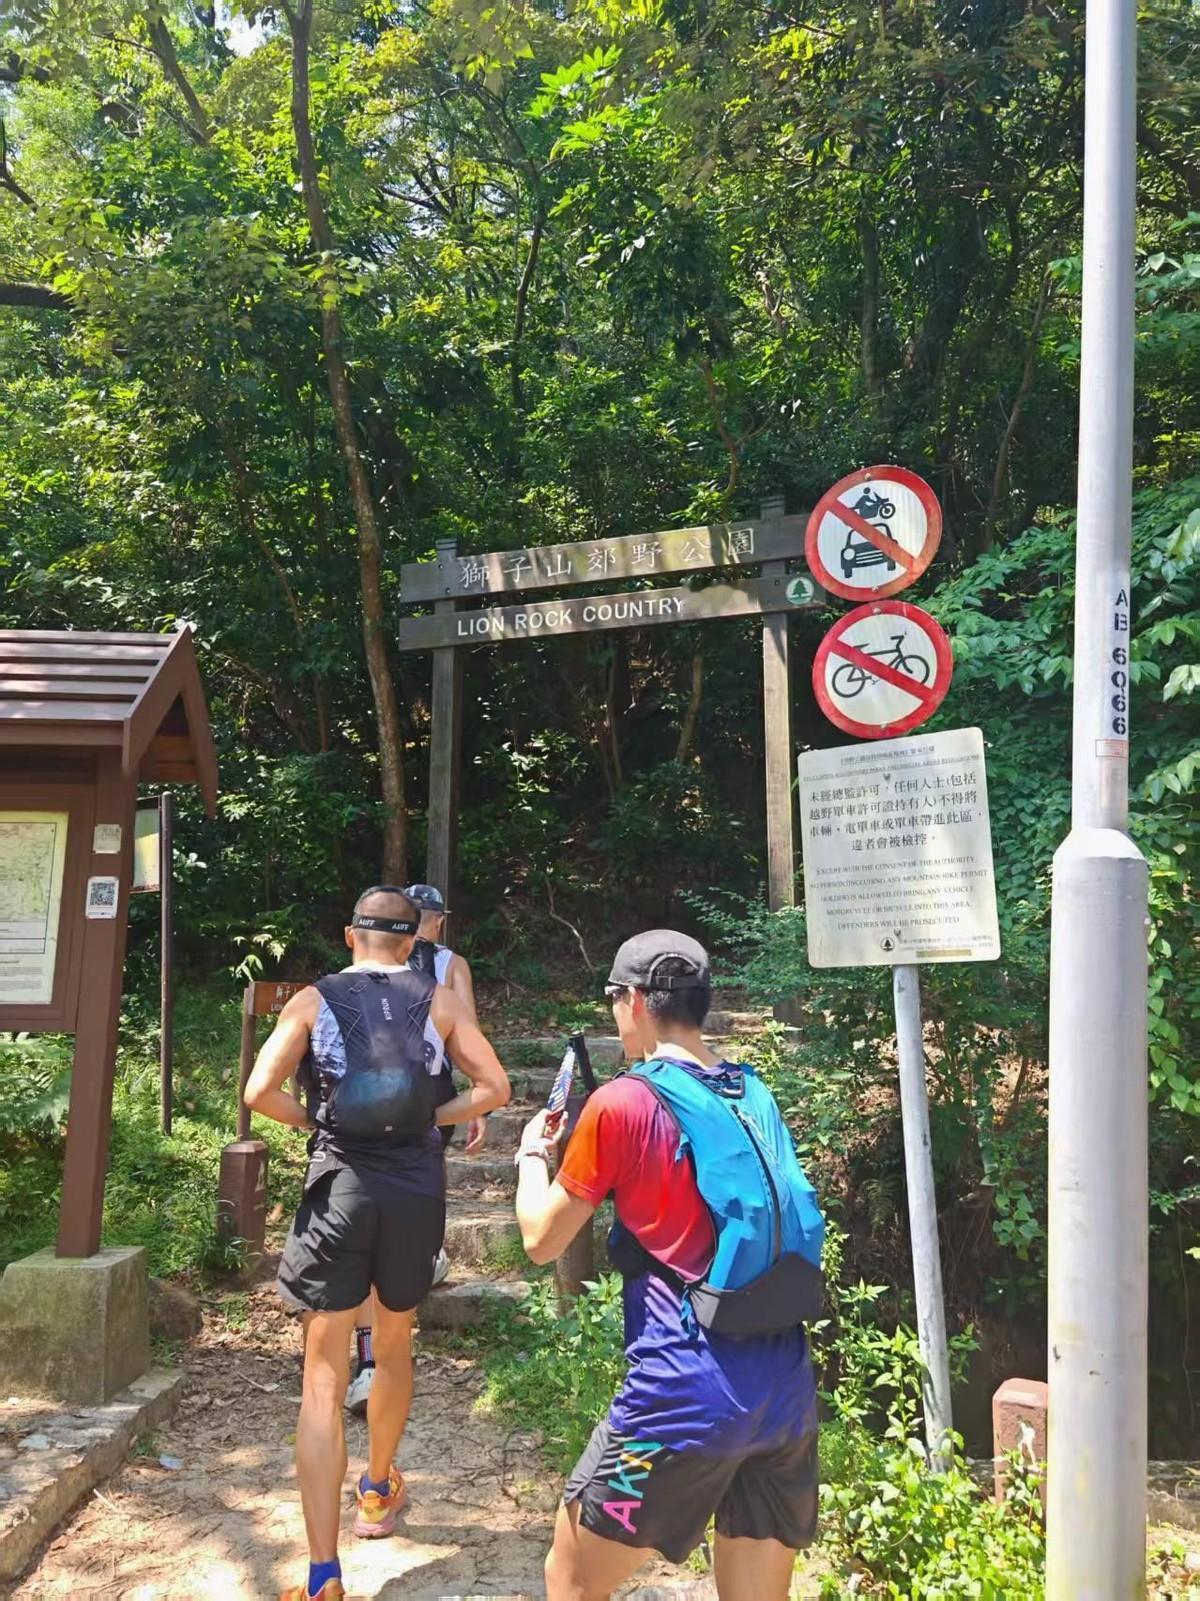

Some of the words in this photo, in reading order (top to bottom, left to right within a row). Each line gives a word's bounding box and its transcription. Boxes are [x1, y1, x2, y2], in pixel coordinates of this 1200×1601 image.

[458, 527, 755, 589] 獅子山郊野公園
[457, 616, 505, 637] LION
[514, 609, 573, 632] ROCK
[582, 597, 686, 622] COUNTRY
[1111, 647, 1128, 736] 6066
